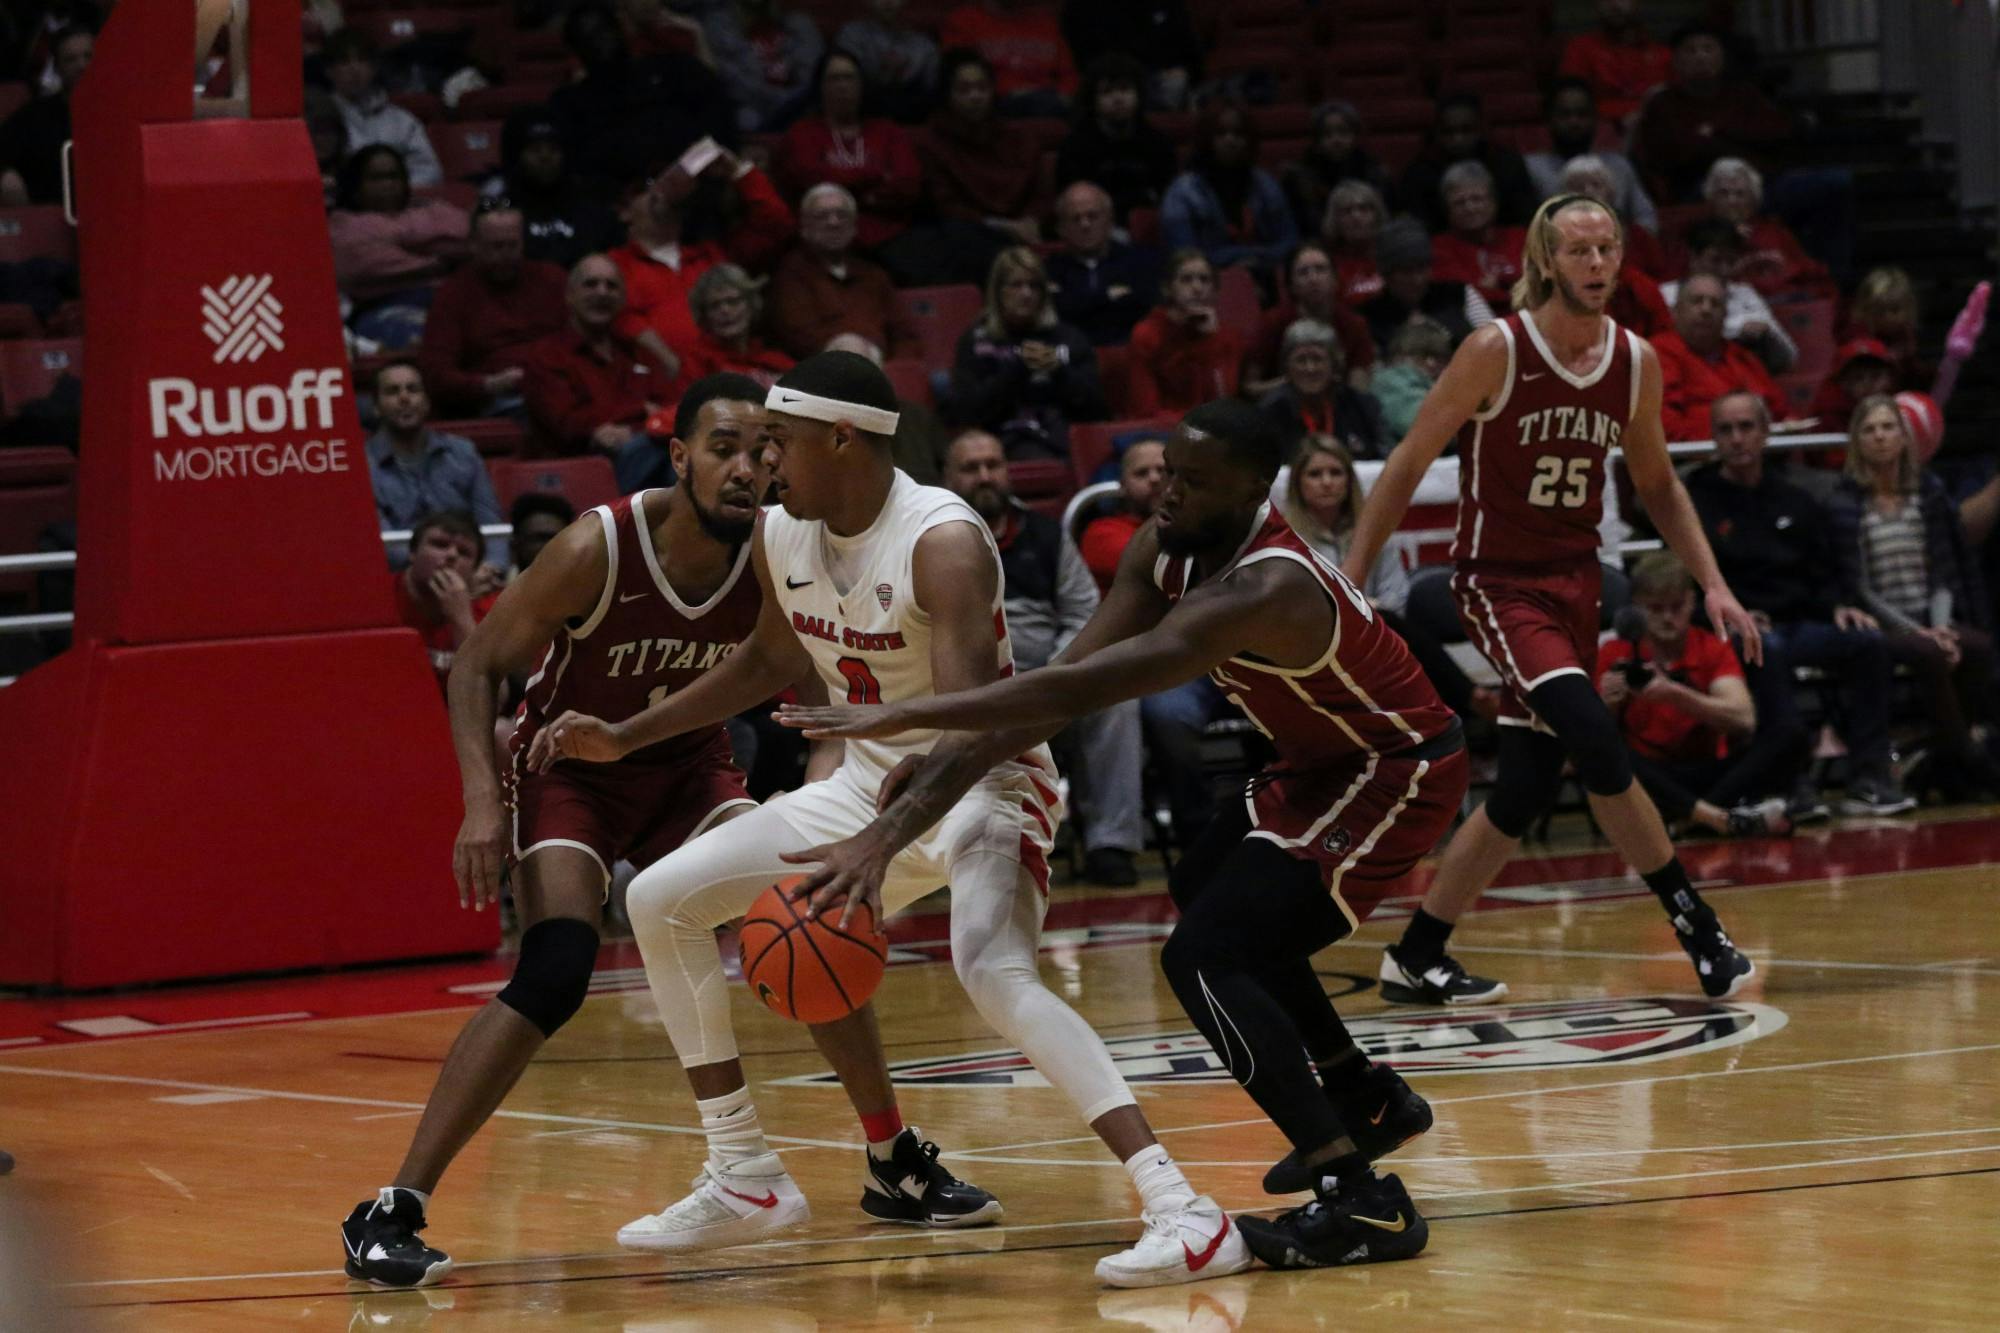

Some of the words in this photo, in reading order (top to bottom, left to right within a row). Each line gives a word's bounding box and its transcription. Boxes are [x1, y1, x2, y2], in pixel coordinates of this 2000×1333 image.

[148, 366, 345, 439] Ruoff
[1517, 405, 1622, 449] TITANS
[153, 438, 350, 482] MORTGAGE
[1527, 455, 1592, 508] 25
[792, 611, 839, 644] BALL
[842, 626, 907, 651] STATE
[836, 656, 883, 705] 0
